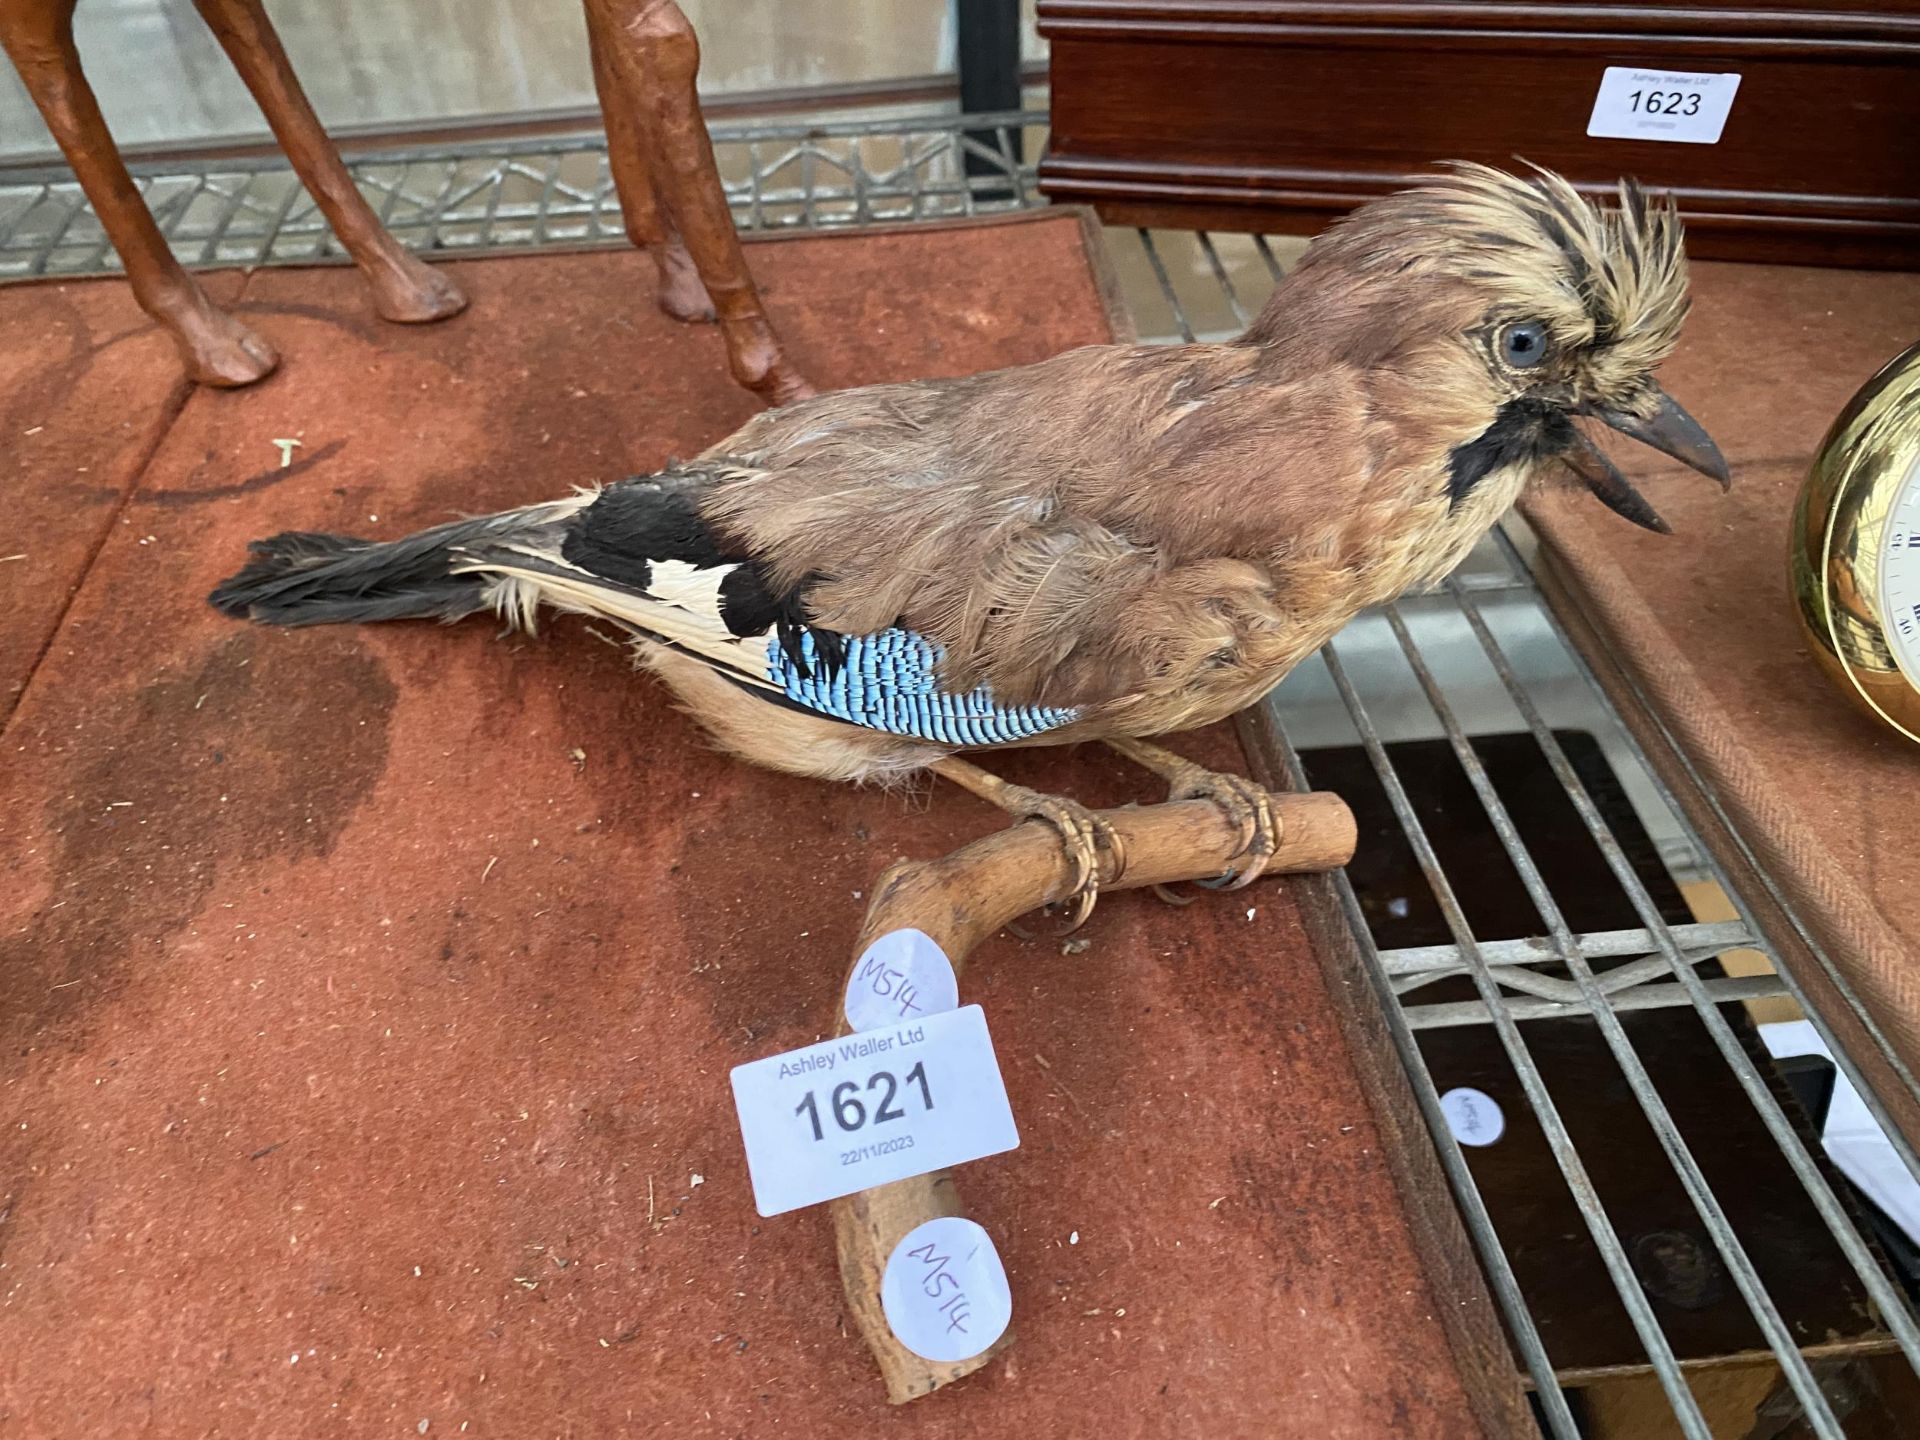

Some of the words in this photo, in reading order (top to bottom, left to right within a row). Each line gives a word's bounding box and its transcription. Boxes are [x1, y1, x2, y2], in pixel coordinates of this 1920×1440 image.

[1629, 90, 1702, 116] 1623
[1897, 617, 1912, 635] 40
[778, 1052, 836, 1079] Ashley
[839, 1038, 894, 1062] Waller
[897, 1026, 925, 1047] Ltd
[795, 1060, 935, 1142] 1621
[840, 1135, 915, 1165] 22/11/2023
